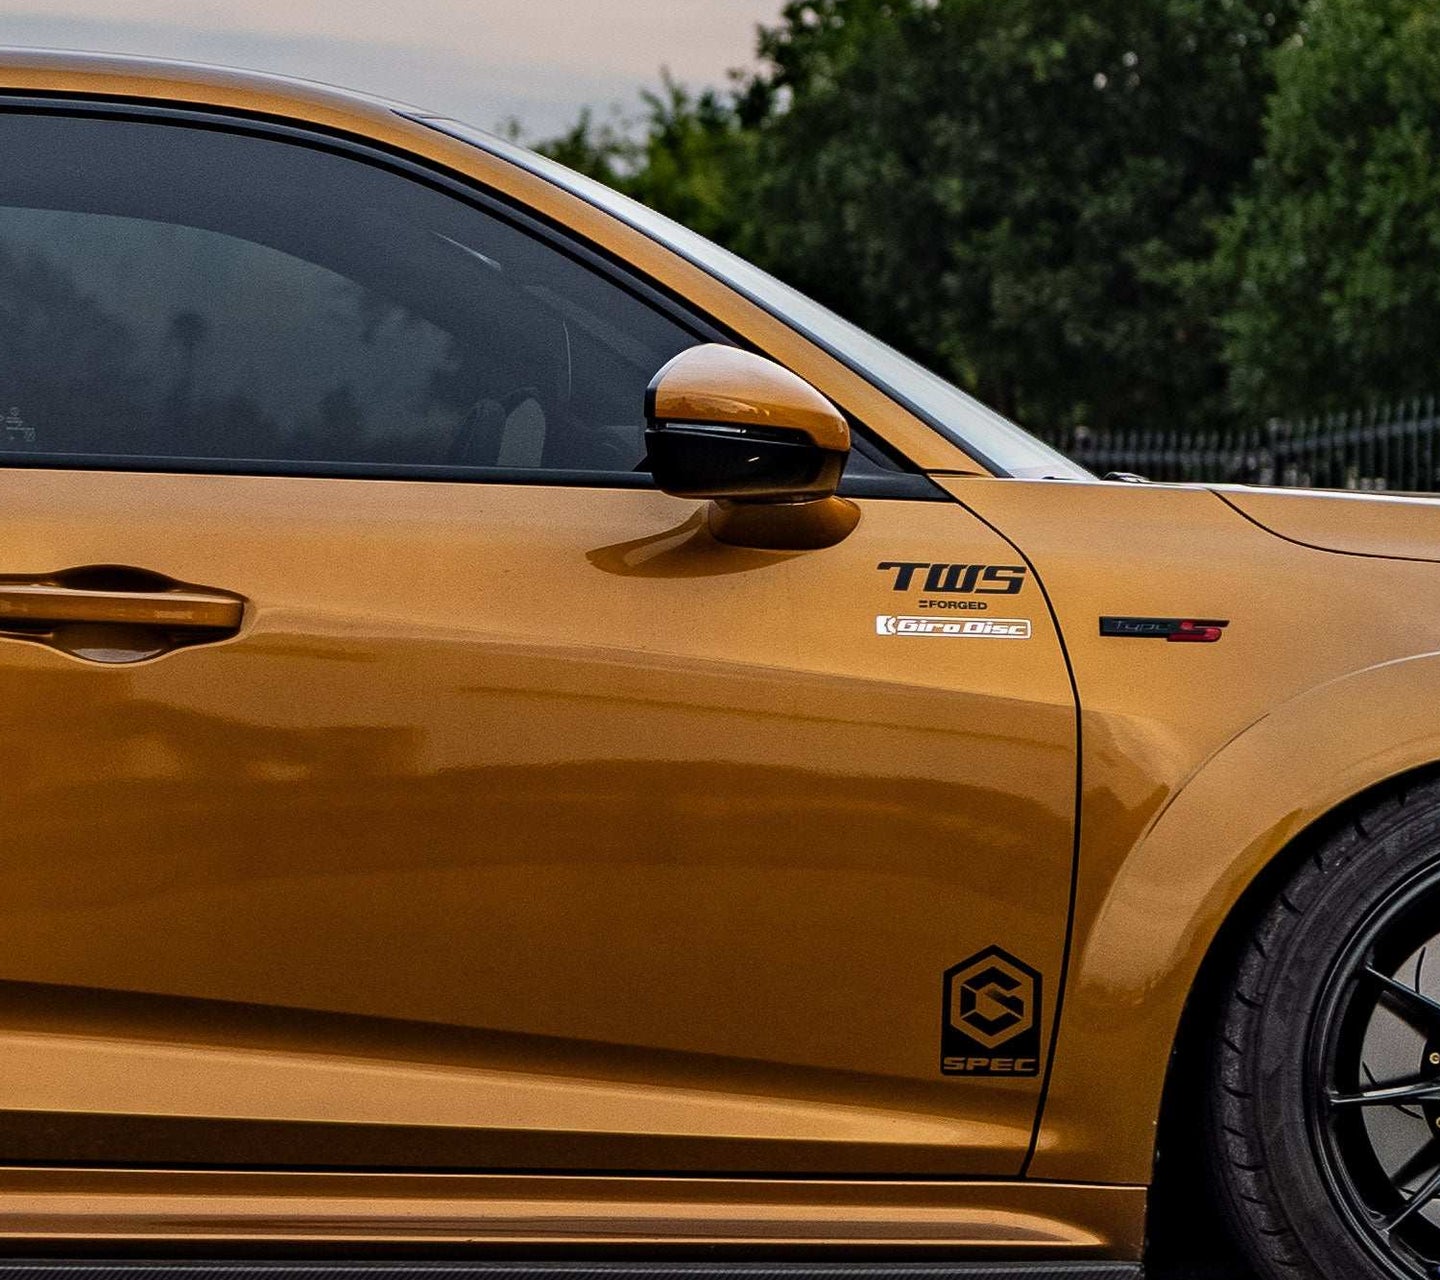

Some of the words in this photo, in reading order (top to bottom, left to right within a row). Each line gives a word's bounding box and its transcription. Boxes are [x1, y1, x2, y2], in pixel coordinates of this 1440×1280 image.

[877, 561, 1027, 594] TWS
[928, 600, 988, 610] FORGED
[943, 1056, 1037, 1072] SPEC
